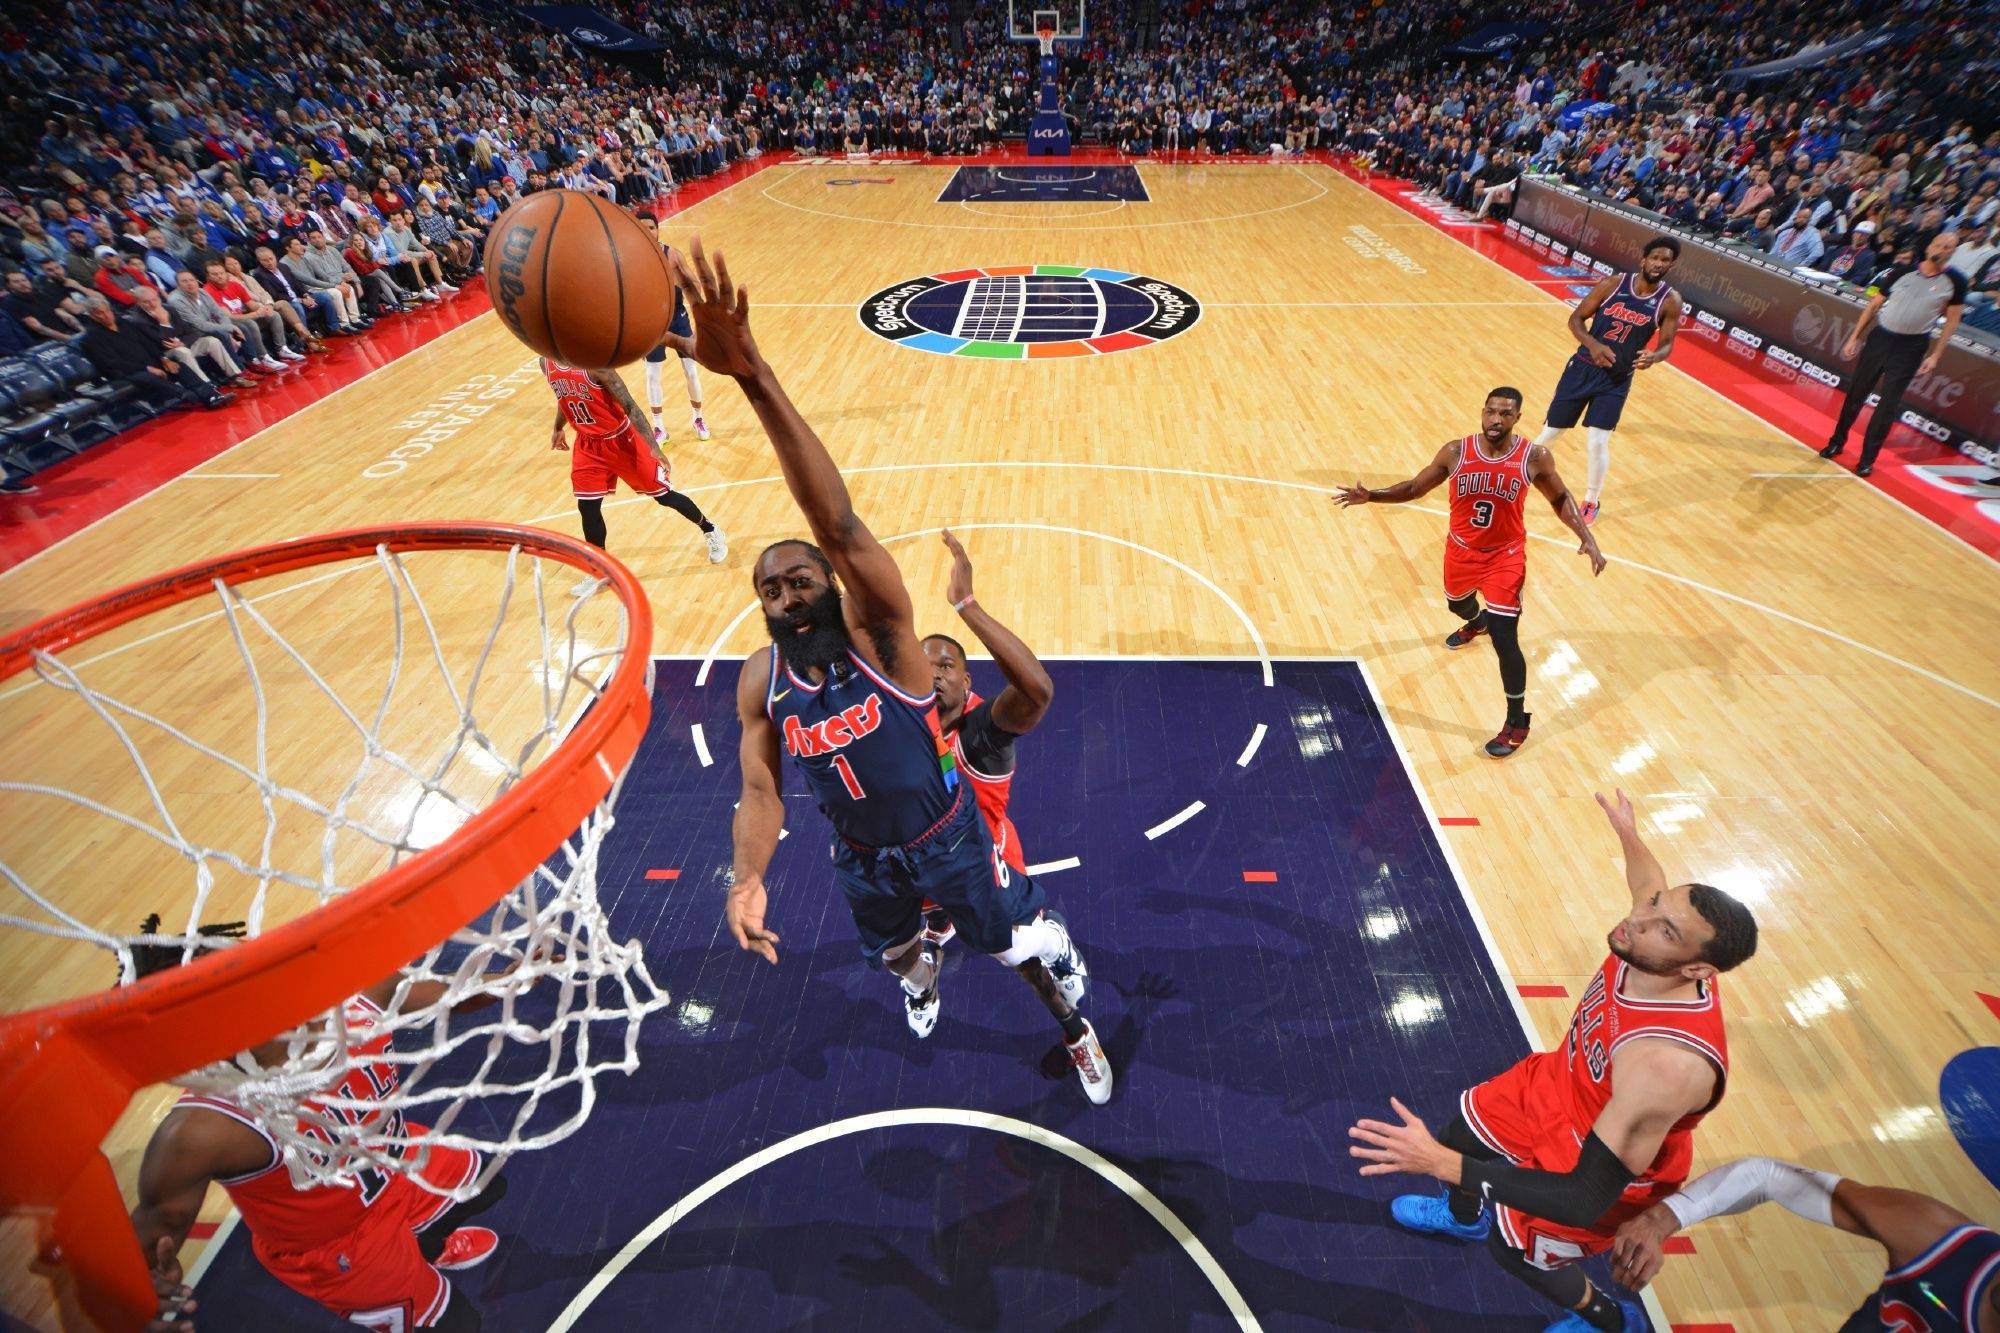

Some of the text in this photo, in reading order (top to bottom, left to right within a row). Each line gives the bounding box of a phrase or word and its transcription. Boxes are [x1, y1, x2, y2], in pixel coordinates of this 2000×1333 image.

[1034, 128, 1064, 138] KIA
[1719, 275, 1771, 319] Therapy
[1552, 241, 1568, 255] GEICO
[1572, 250, 1592, 266] GEICO
[1593, 261, 1614, 277] GEICO
[1696, 310, 1726, 331] GEICO
[1730, 326, 1763, 348] GEICO
[1768, 344, 1803, 369] GEICO
[1802, 361, 1841, 388] GEICO
[1901, 410, 1951, 442] GEICO
[1603, 320, 1633, 344] 21
[391, 374, 498, 430] CENTER
[551, 378, 594, 401] BULLS
[568, 401, 597, 425] 11
[362, 403, 498, 479] FARGO
[1457, 471, 1520, 502] BULLS
[1470, 500, 1495, 529] 3
[829, 753, 867, 801] 1
[1581, 970, 1609, 1083] ULLS
